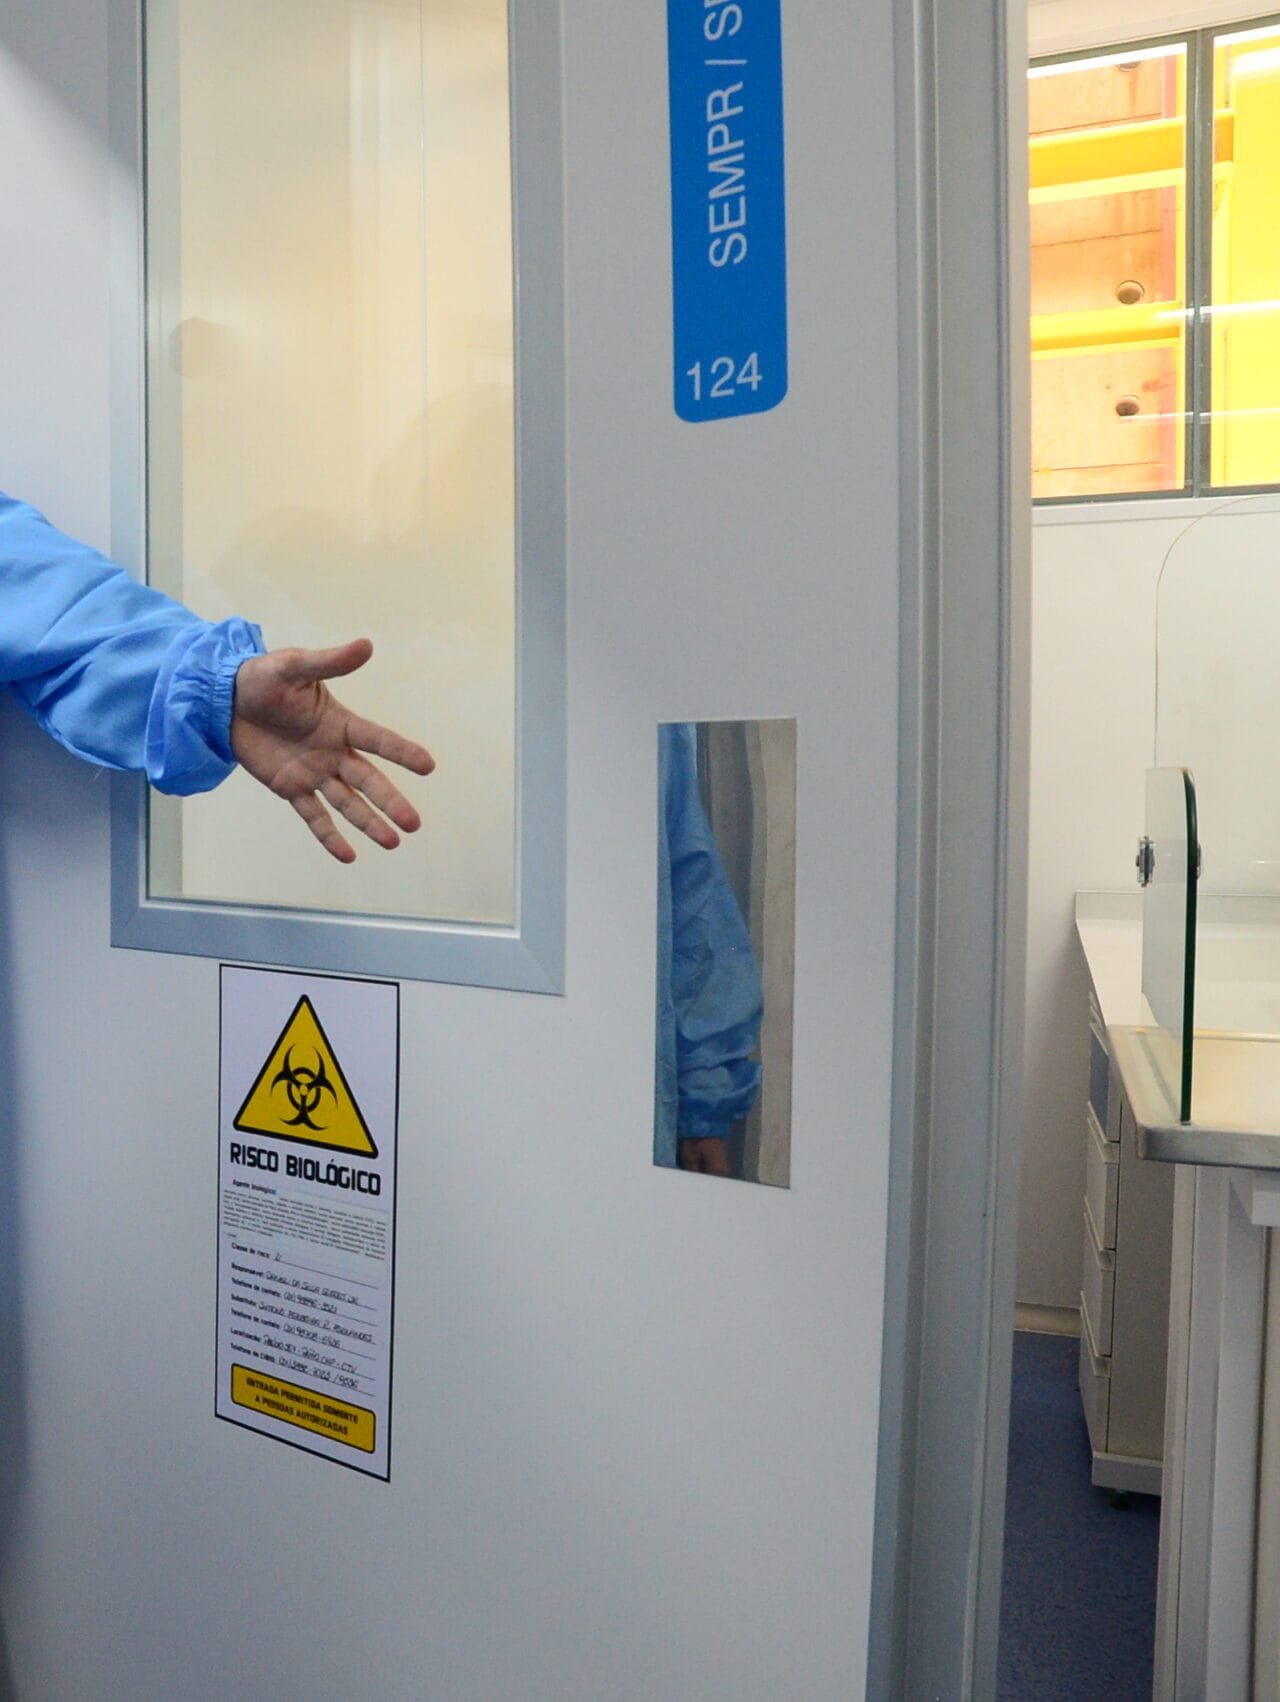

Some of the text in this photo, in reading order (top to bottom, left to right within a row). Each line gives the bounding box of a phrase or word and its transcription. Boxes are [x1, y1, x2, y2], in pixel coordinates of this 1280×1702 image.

[707, 81, 747, 268] SEMPR
[686, 352, 762, 400] 124
[230, 1142, 381, 1196] RISCO BIOLÓGICO
[246, 1377, 358, 1423] ENTRADA PERMITIDA SOMENTE
[262, 1398, 294, 1416] PESSOAS
[296, 1410, 348, 1435] AUTORIZADAS
